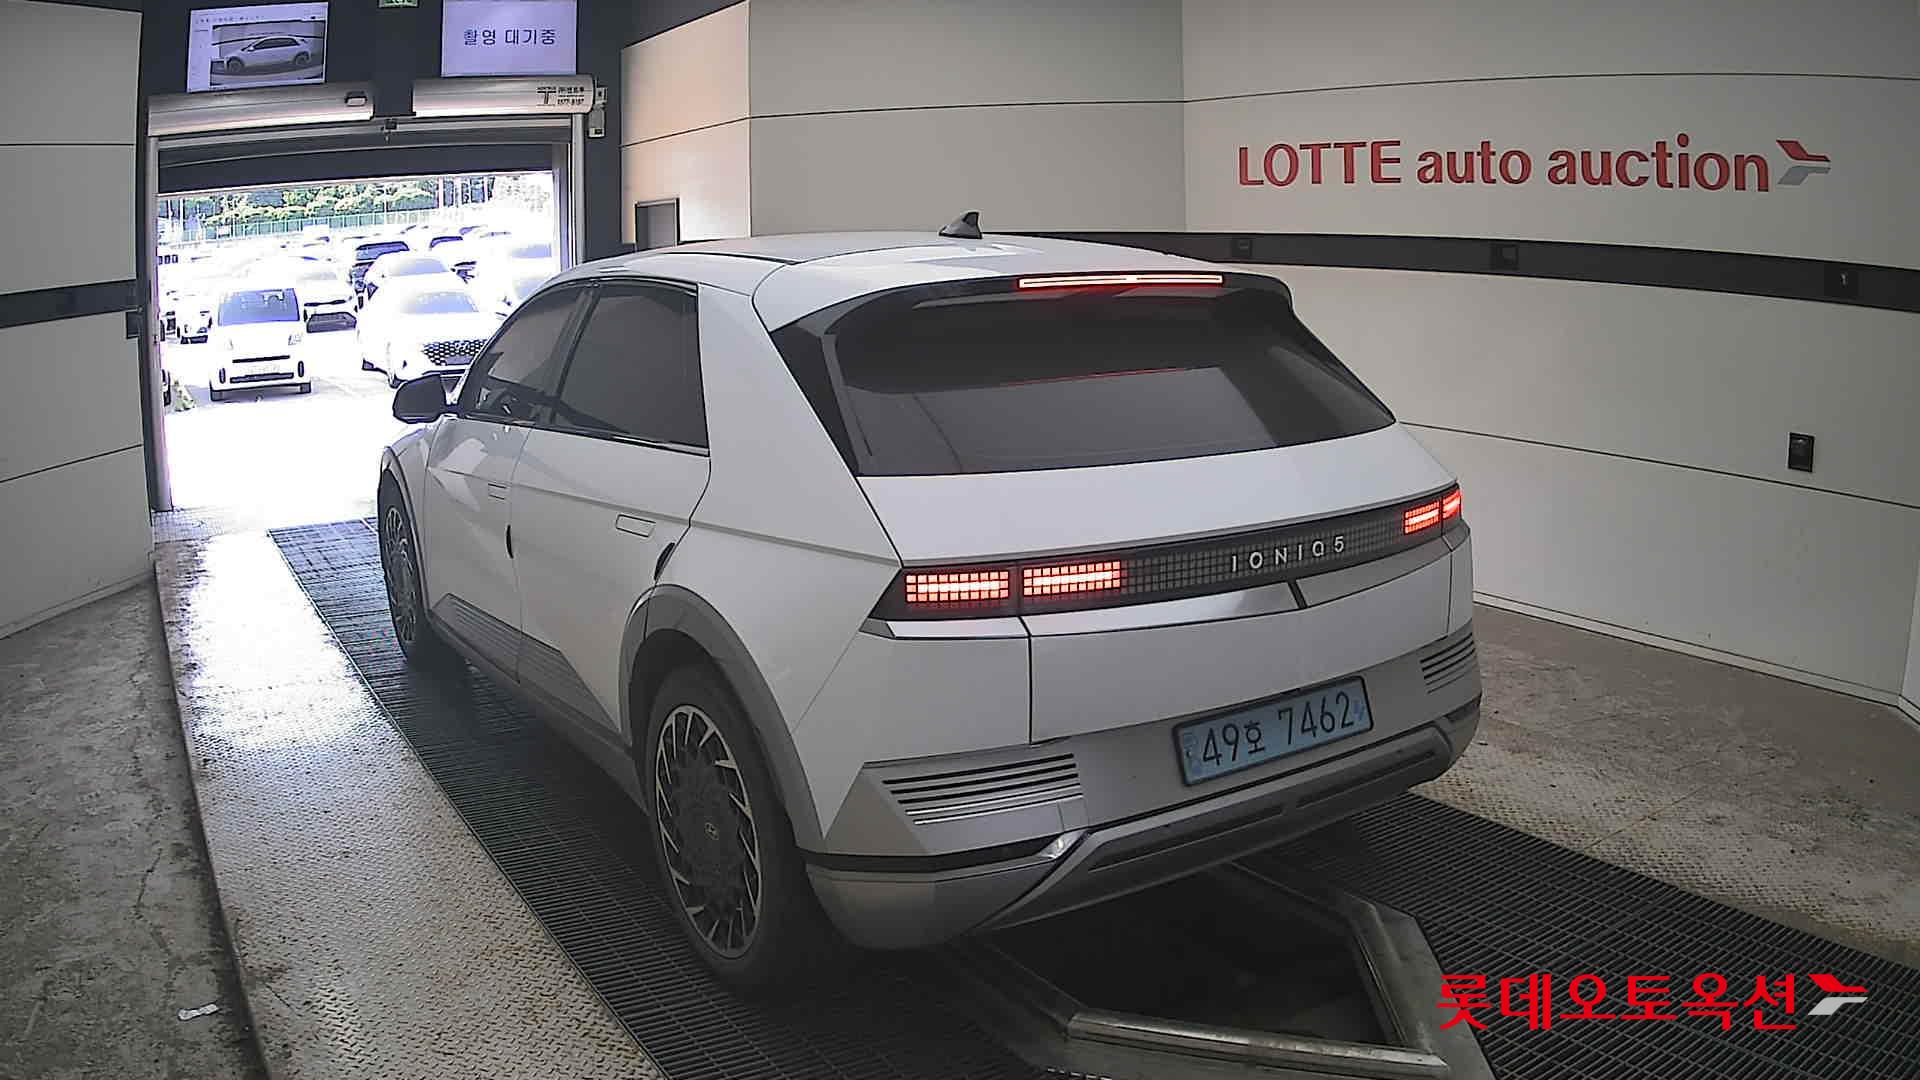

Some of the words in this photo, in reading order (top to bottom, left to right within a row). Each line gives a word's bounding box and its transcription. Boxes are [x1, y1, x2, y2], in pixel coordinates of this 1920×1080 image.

[464, 29, 496, 46] 촬영
[504, 28, 555, 45] 대기중
[1238, 139, 1401, 187] LOTTE
[1416, 140, 1532, 186] auto
[1547, 133, 1770, 193] auction
[1202, 719, 1266, 766] 49호
[1277, 691, 1355, 746] 7462
